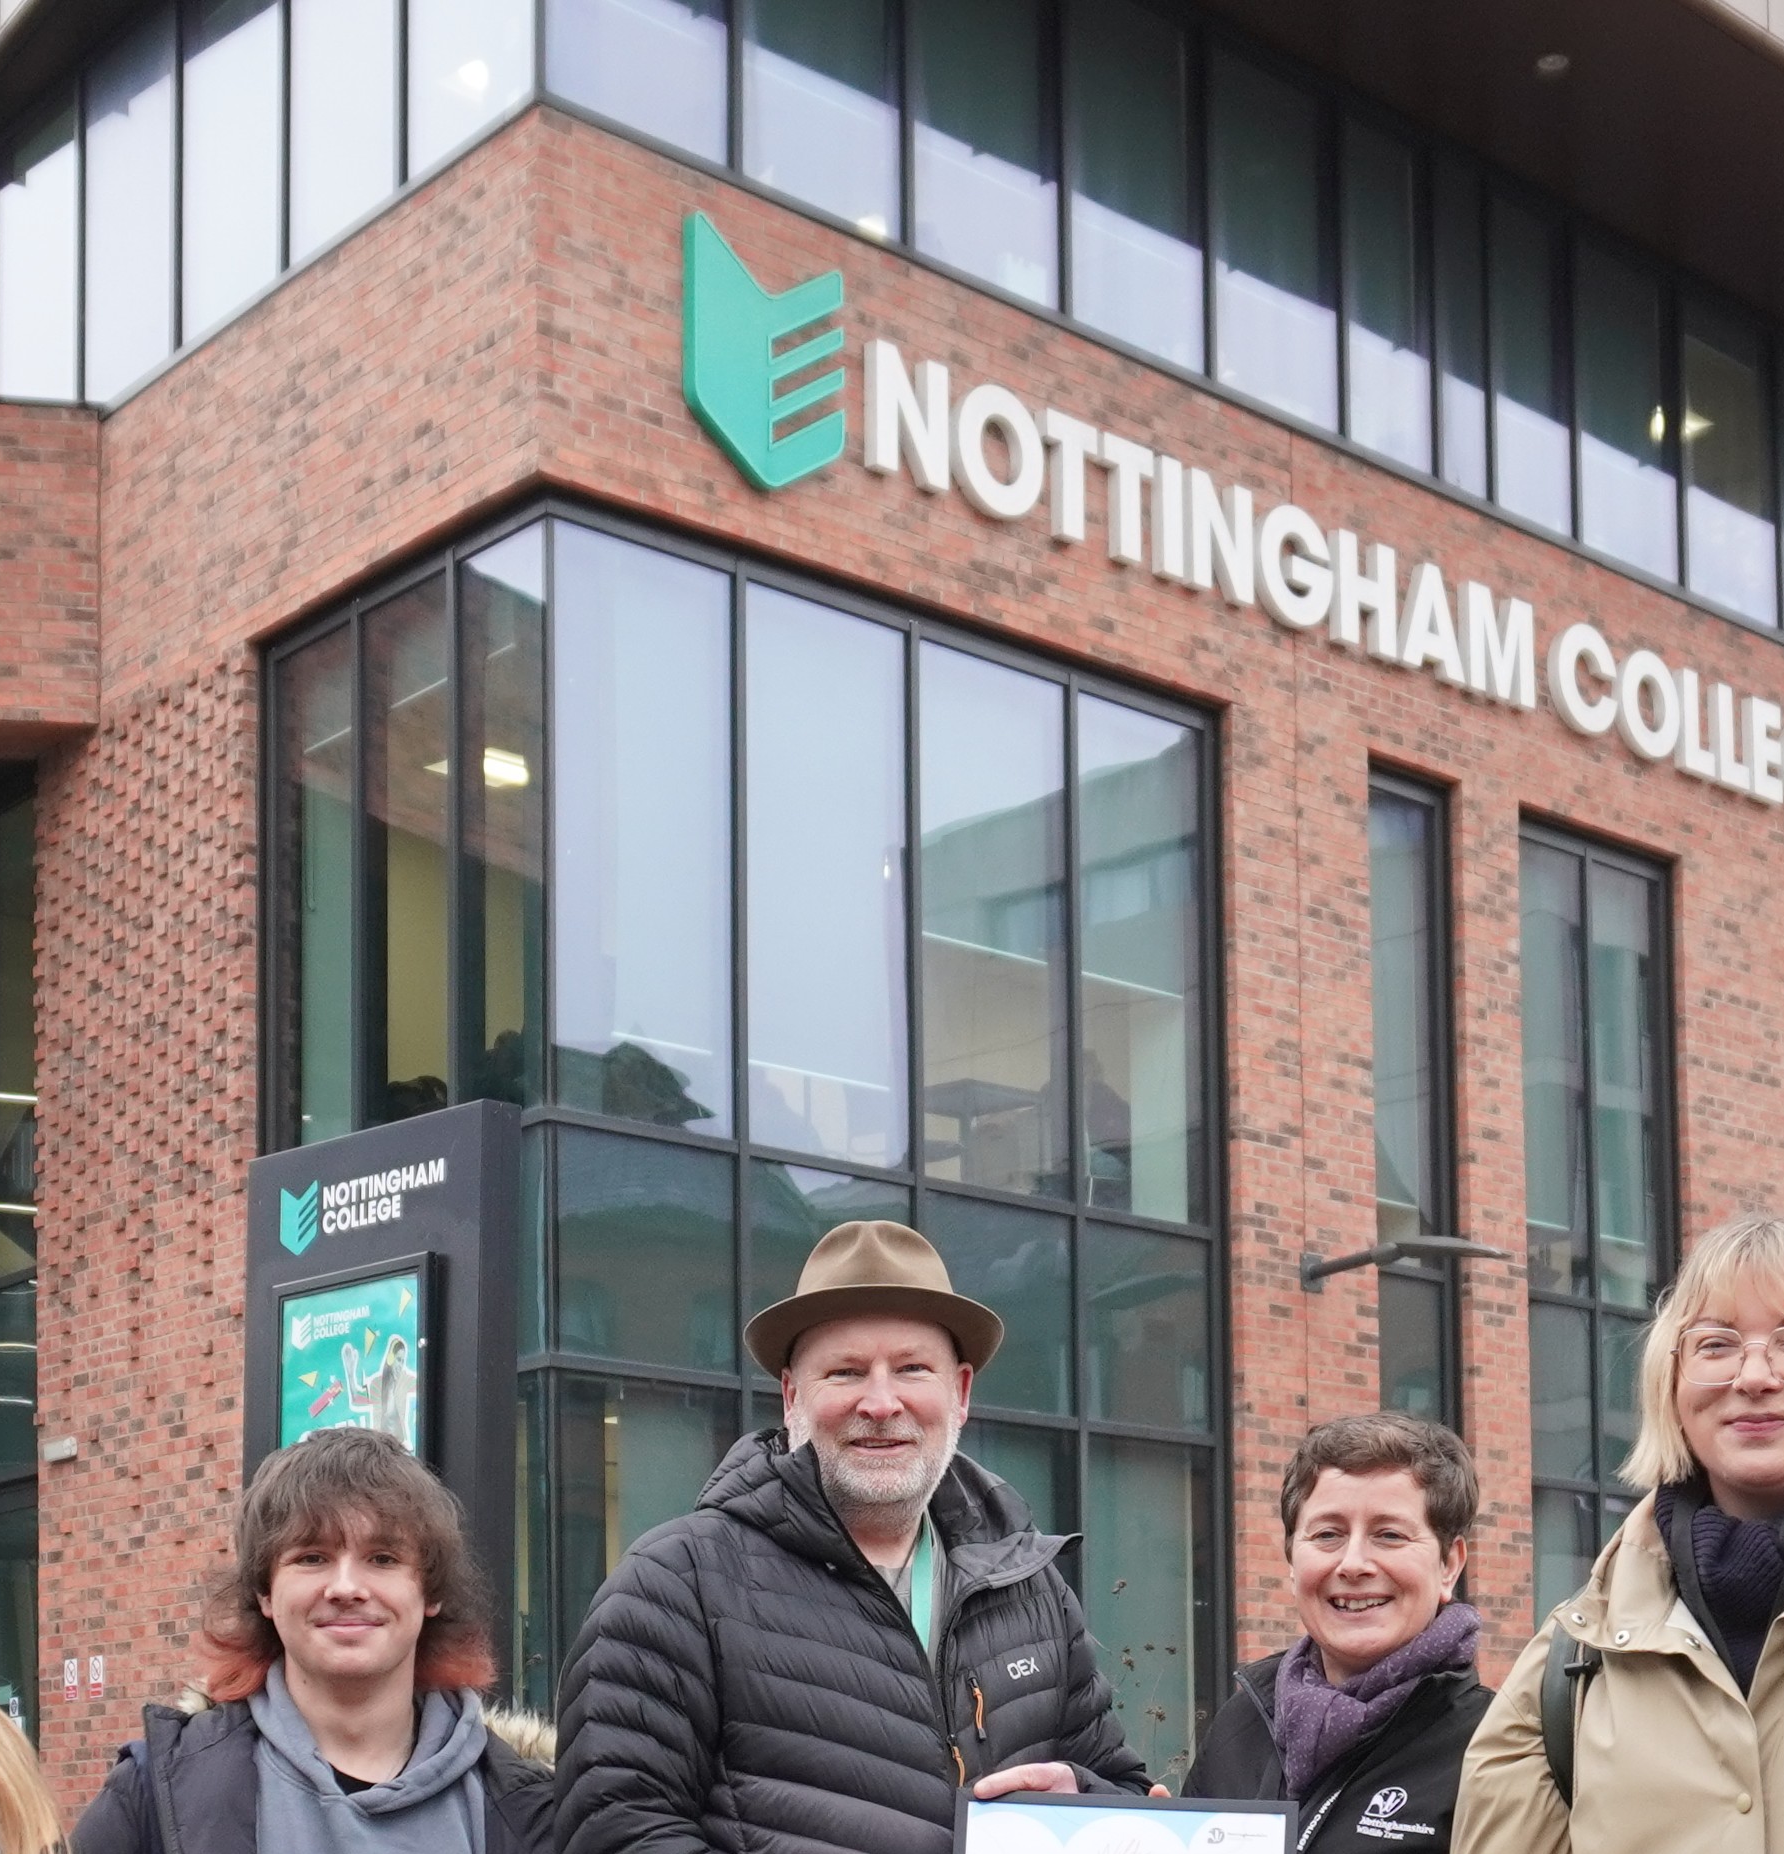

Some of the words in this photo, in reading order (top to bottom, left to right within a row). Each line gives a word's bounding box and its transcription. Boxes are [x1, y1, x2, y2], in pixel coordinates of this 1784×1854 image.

[864, 338, 1537, 712] NOTTINGHAM
[322, 1157, 445, 1210] NOTTINGHAM
[322, 1194, 402, 1234] COLLEGE
[313, 1305, 370, 1327] NOTTINGHAM
[313, 1321, 350, 1340] COLLEGE
[1007, 1656, 1040, 1680] OEX
